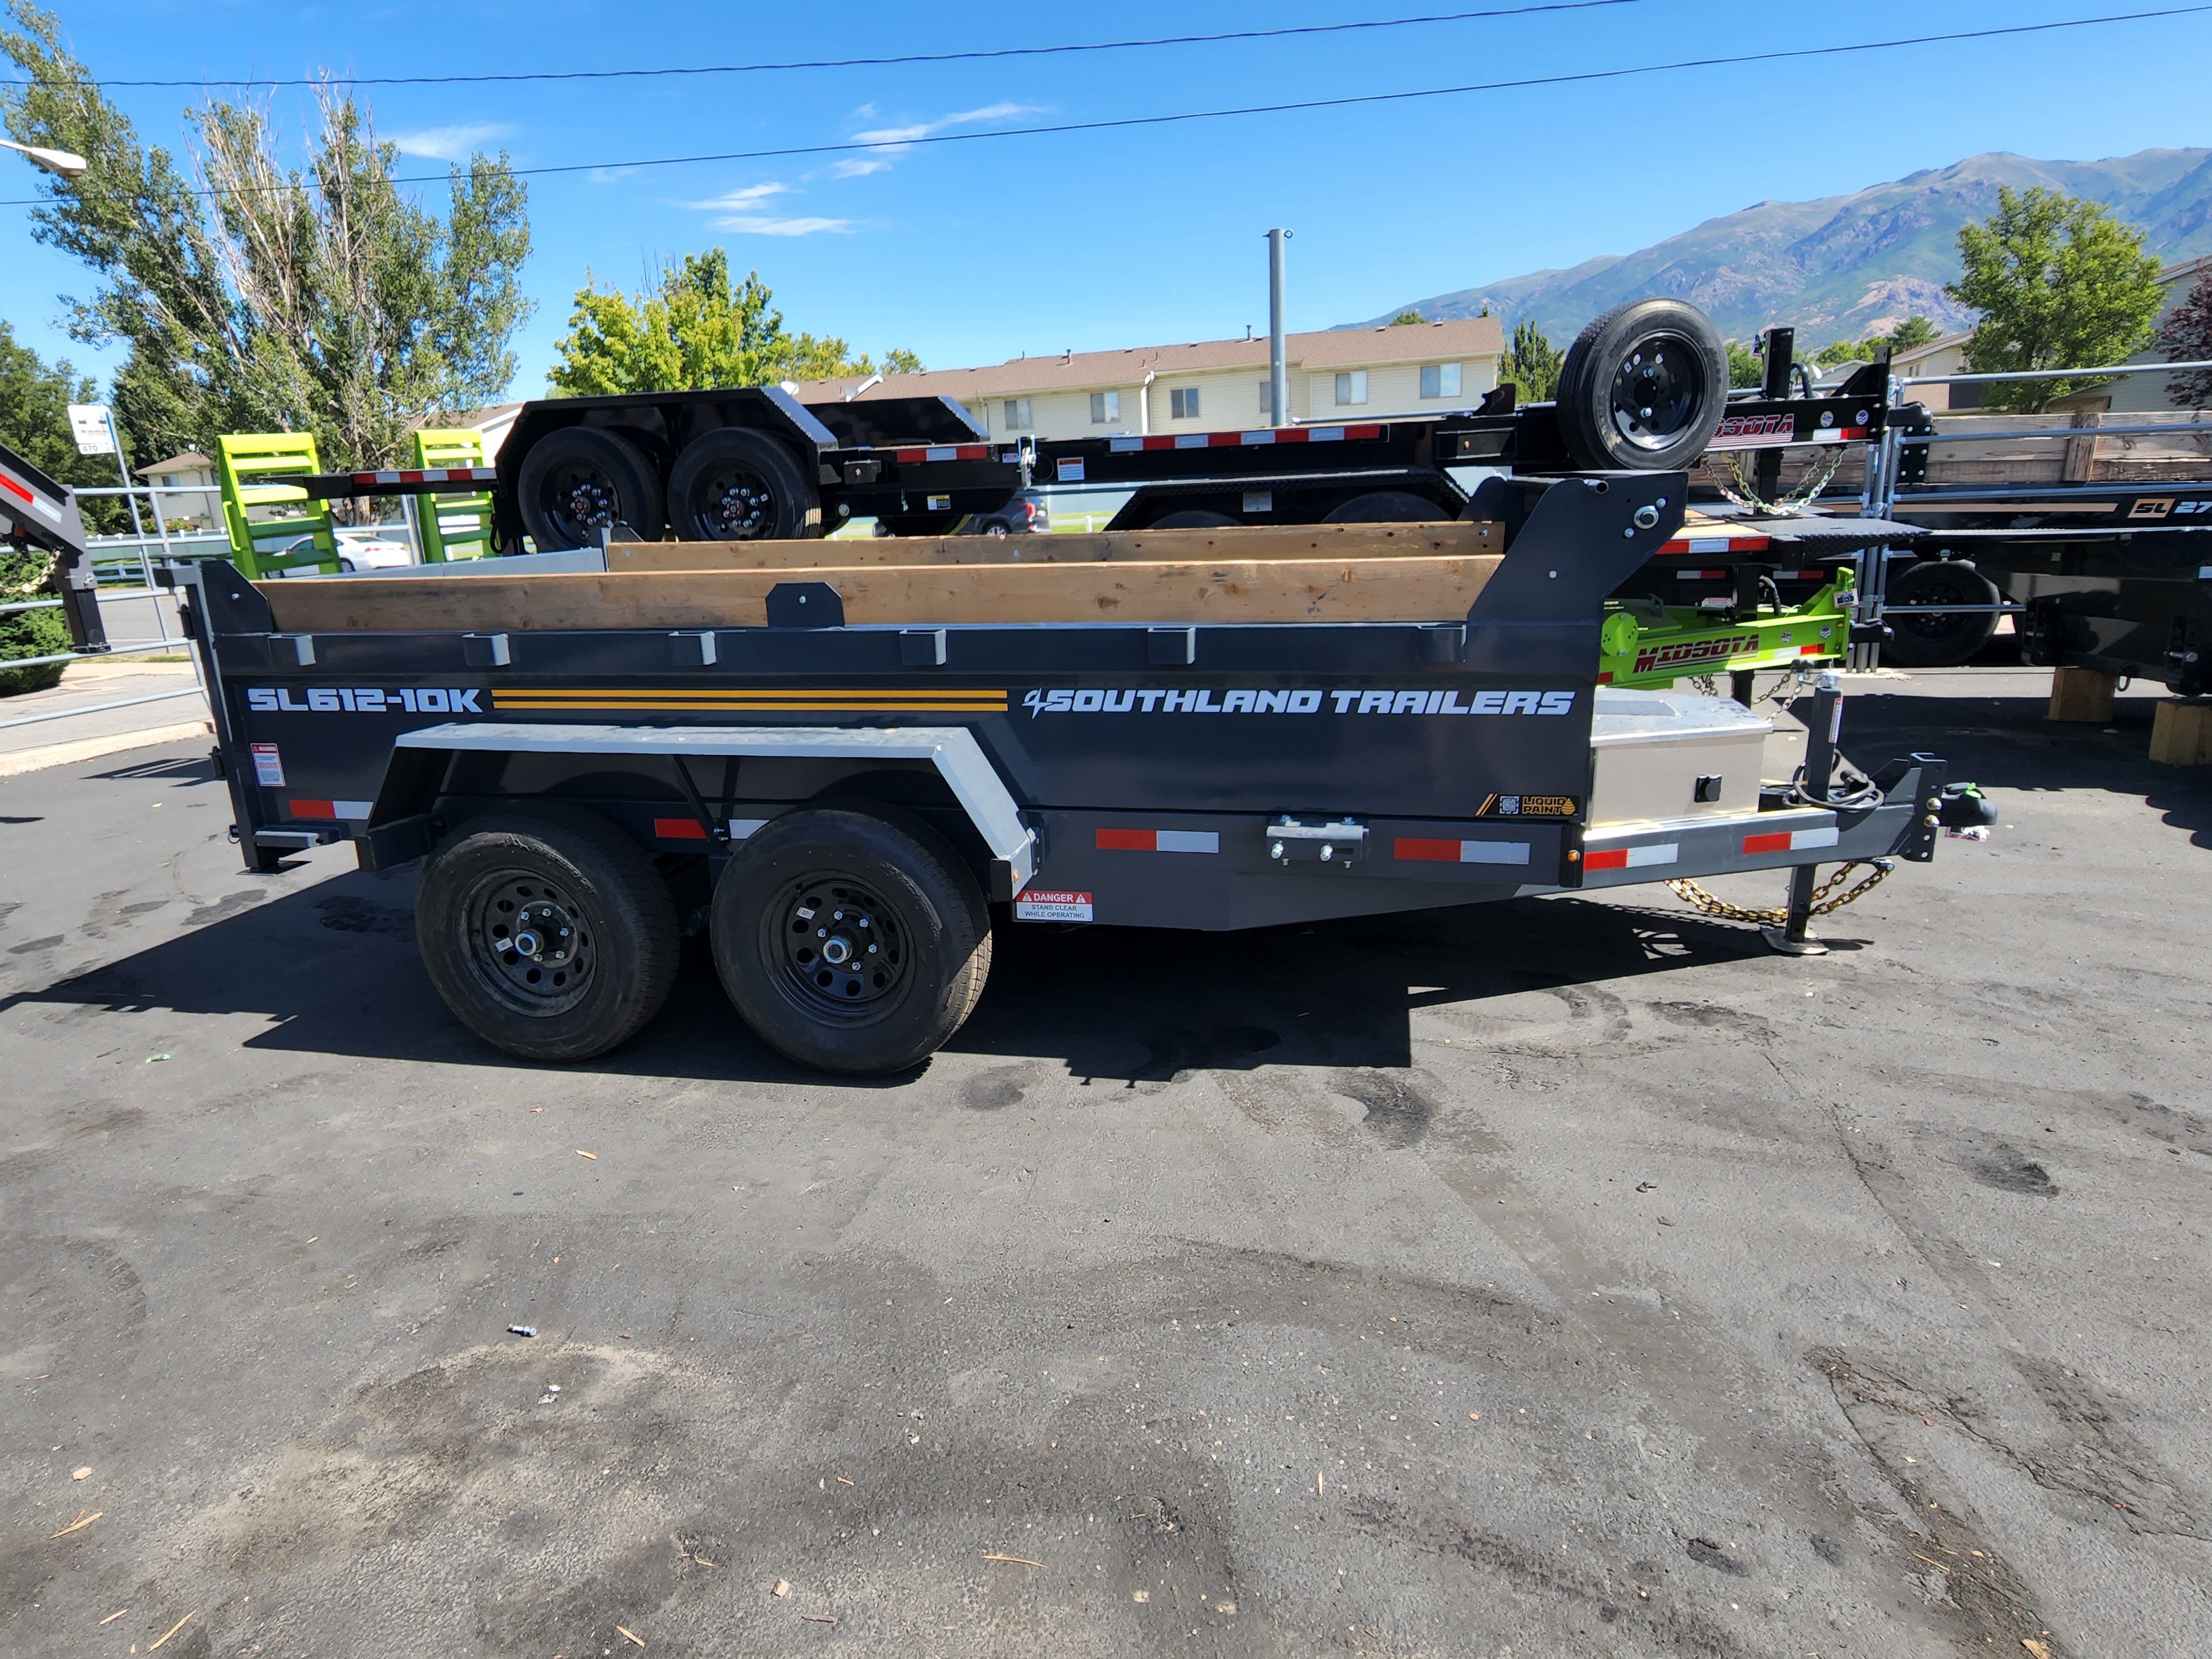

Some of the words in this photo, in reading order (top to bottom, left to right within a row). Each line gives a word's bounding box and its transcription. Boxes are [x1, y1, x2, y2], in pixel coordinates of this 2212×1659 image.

[1714, 414, 1794, 437] SOTA
[2133, 503, 2168, 513] SL
[1632, 634, 1760, 674] MIDSOTA
[247, 688, 483, 713] SL612-10K
[1044, 689, 1323, 713] SOUTHLAND
[1331, 690, 1576, 716] TRAILERS
[1522, 796, 1567, 806] LIQUID
[1521, 805, 1563, 815] PAINT
[1033, 893, 1074, 902] DANGER
